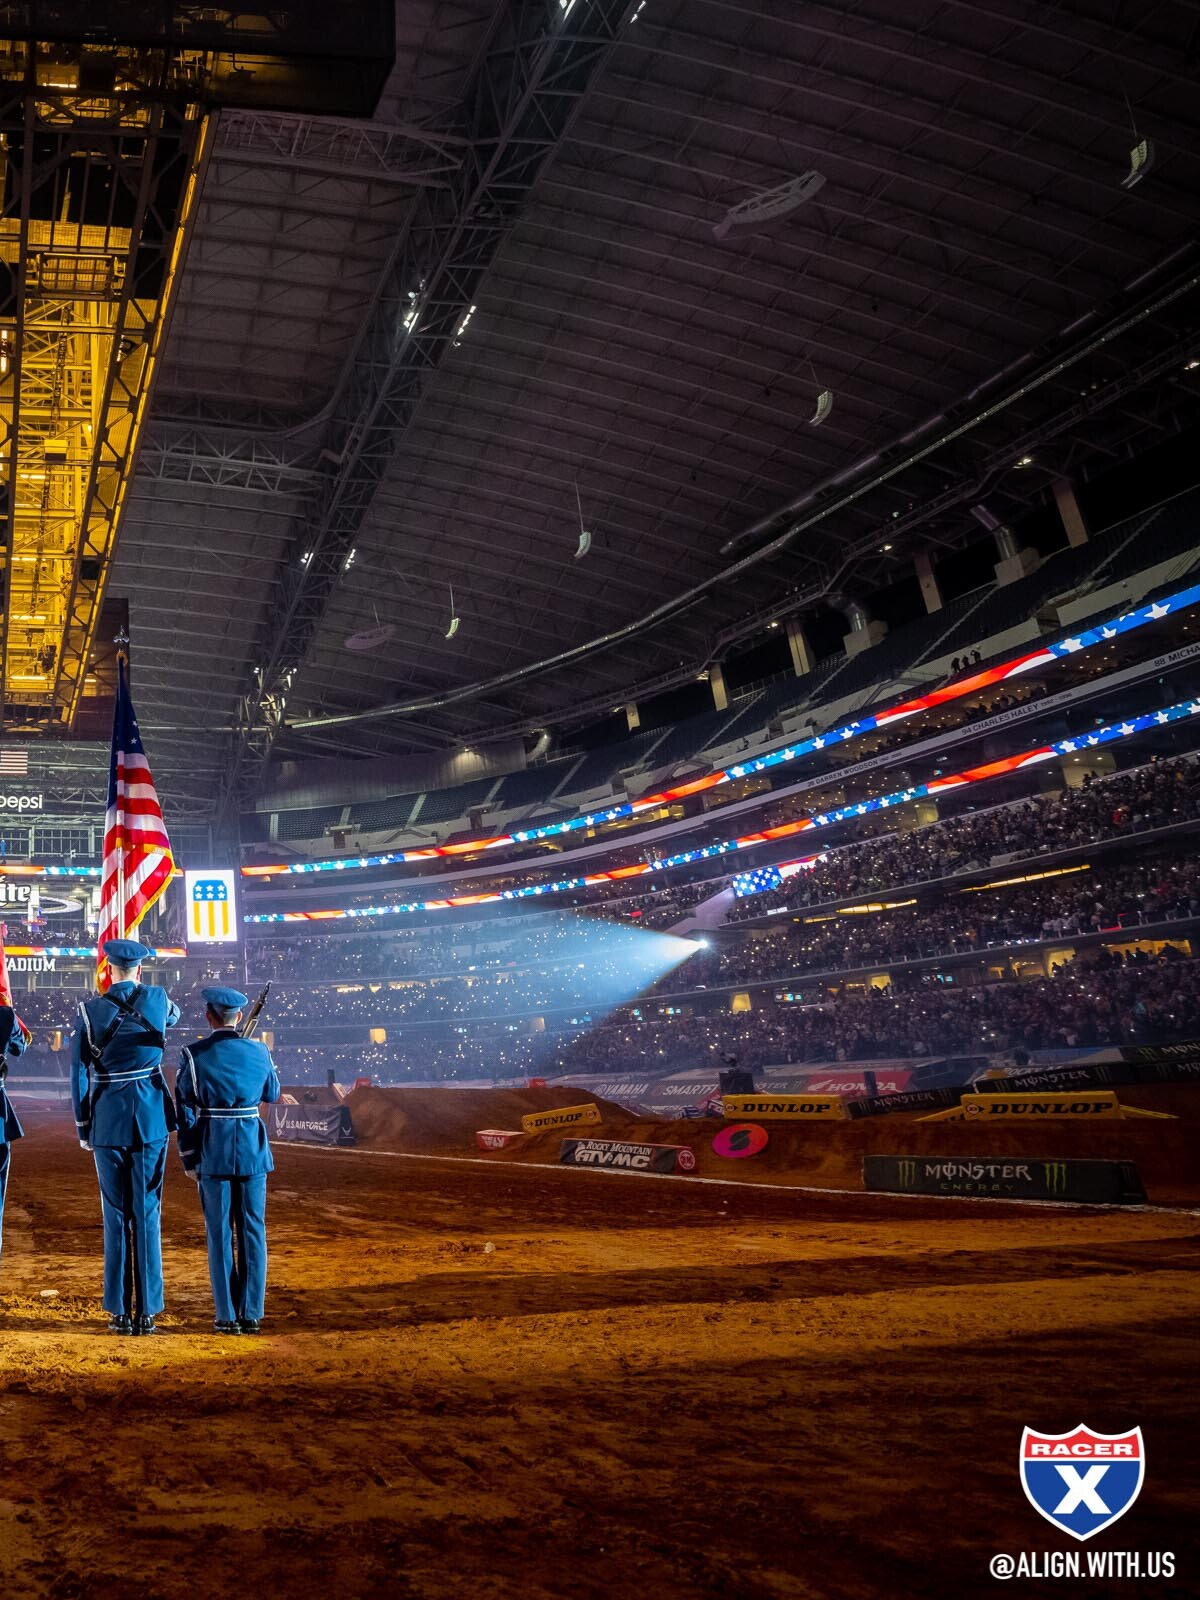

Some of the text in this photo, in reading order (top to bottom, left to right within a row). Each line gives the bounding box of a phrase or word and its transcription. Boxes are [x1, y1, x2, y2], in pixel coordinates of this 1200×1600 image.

[961, 727, 972, 736] 94
[972, 715, 1011, 732] CHARLES
[1011, 703, 1039, 719] HALEY
[3, 956, 56, 972] ADIUM
[604, 1083, 649, 1096] YAMAHA
[742, 1103, 830, 1113] DUNLOP
[989, 1102, 1114, 1114] DUNLOP
[535, 1112, 583, 1127] DUNLOP
[586, 1141, 653, 1156] ROCKY MOUNTAIN
[924, 1161, 1032, 1181] MONSTER
